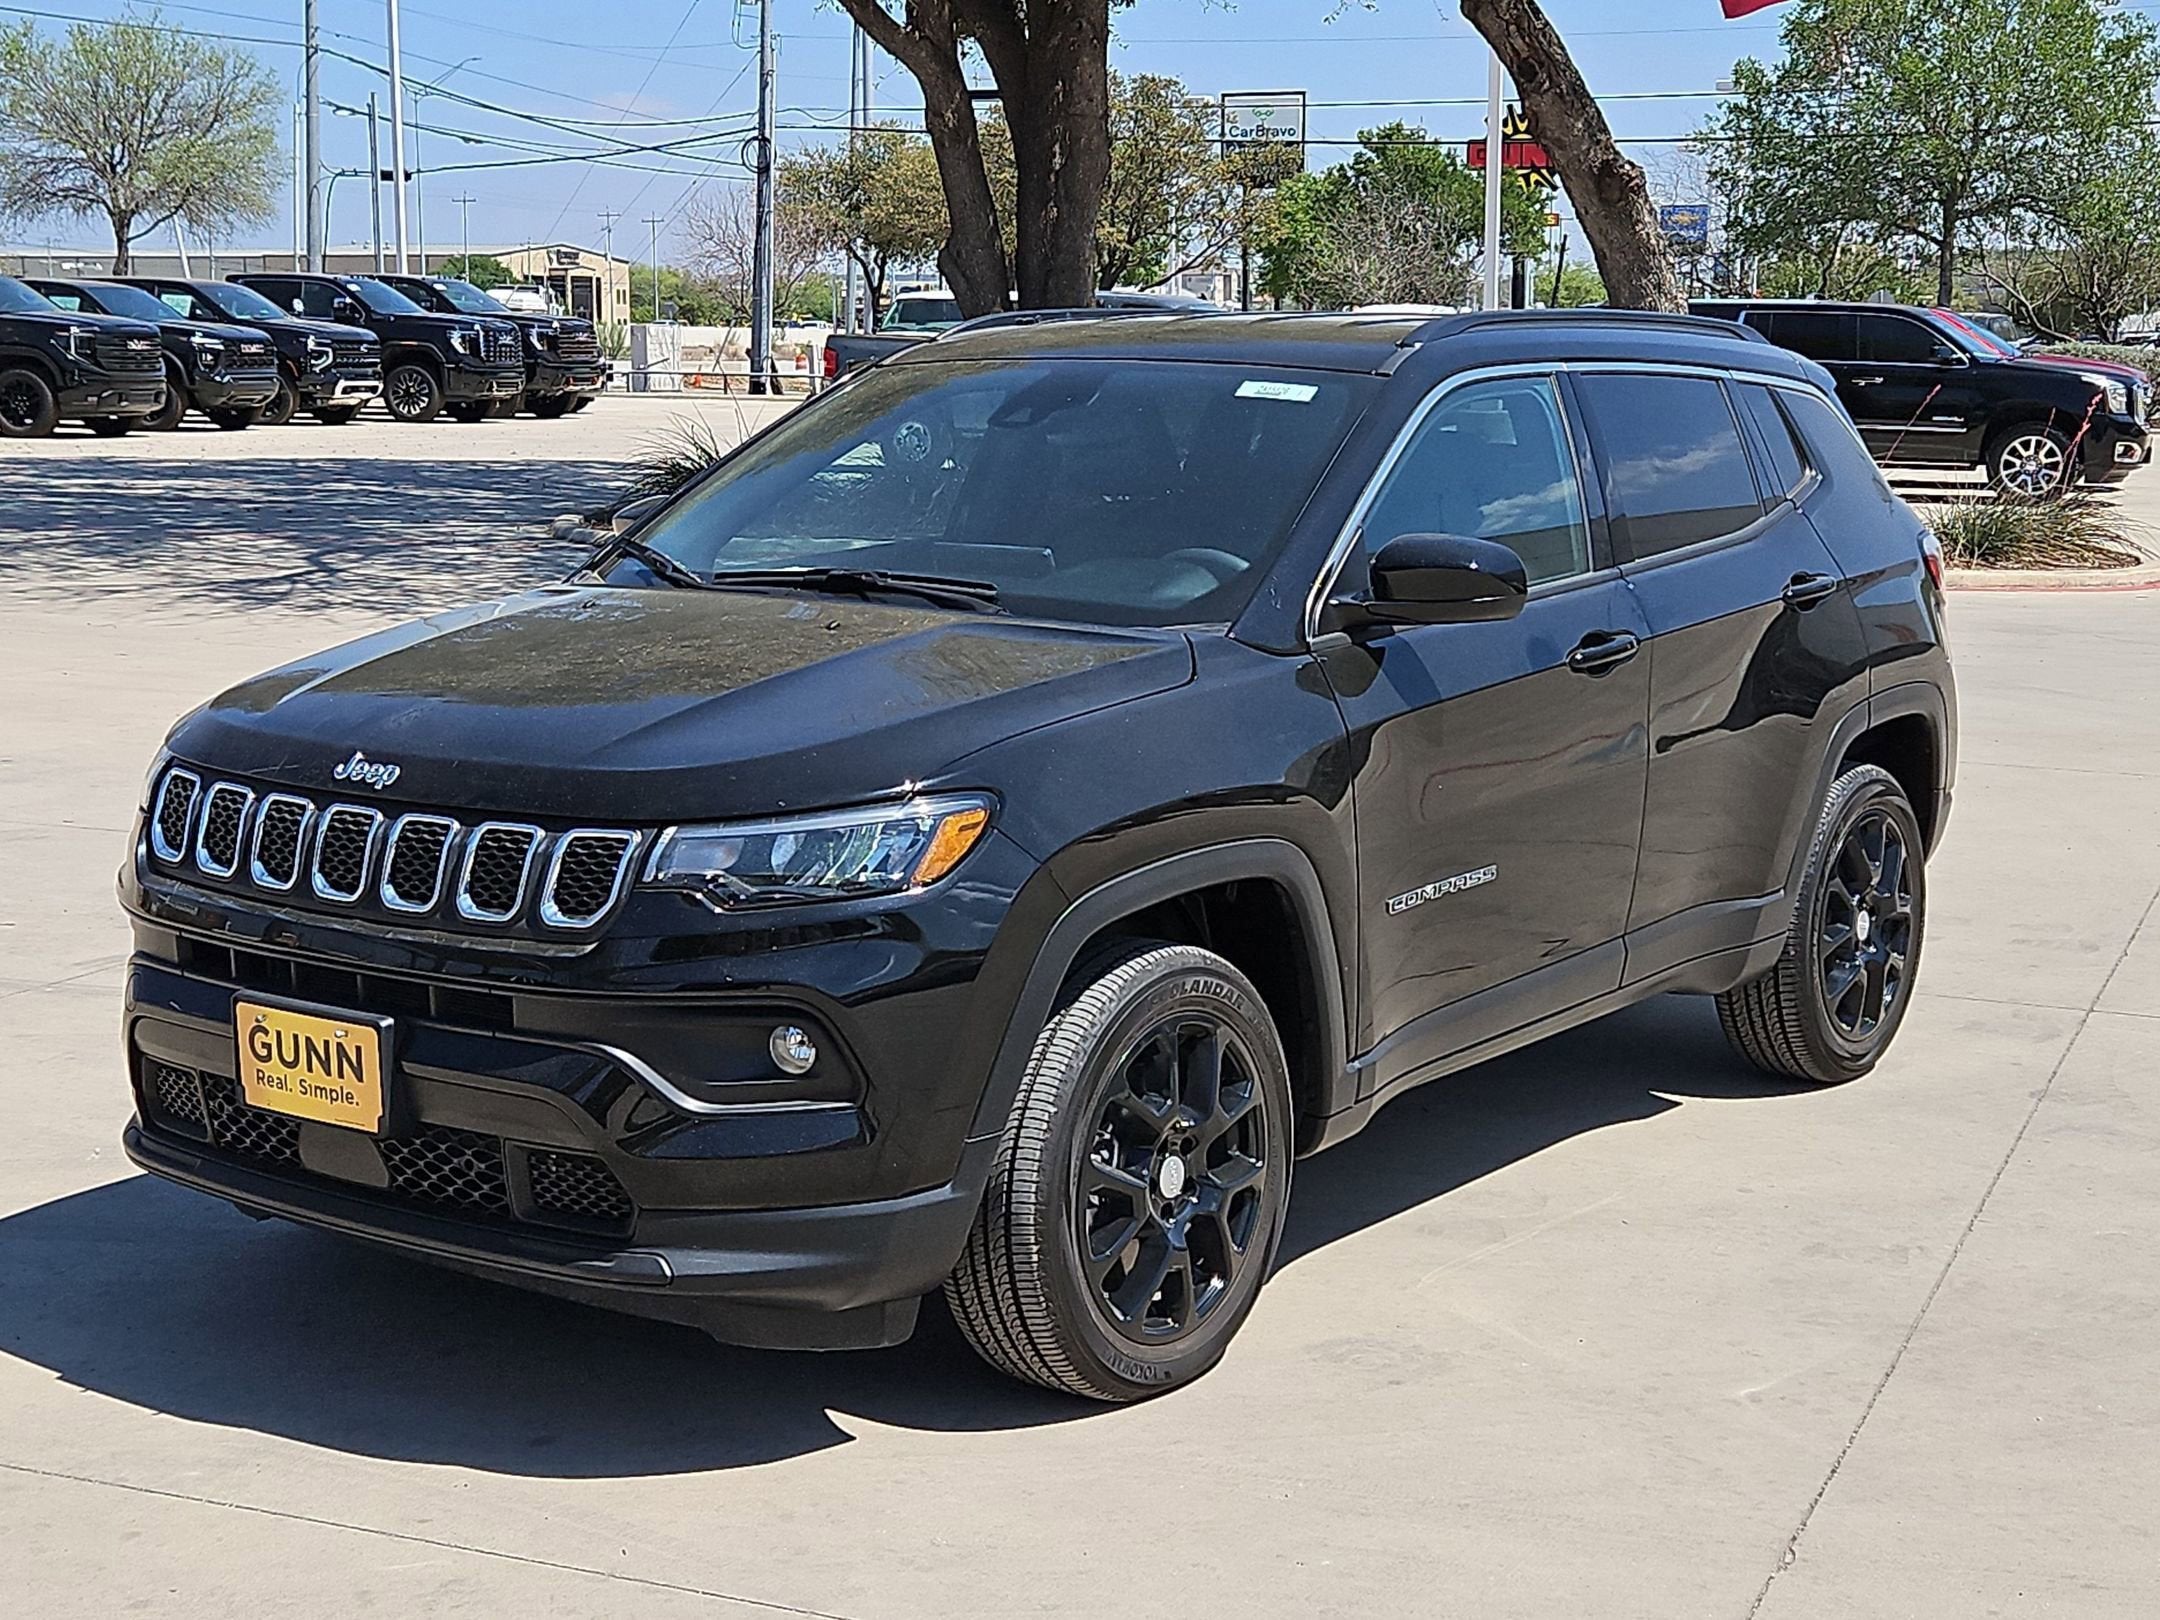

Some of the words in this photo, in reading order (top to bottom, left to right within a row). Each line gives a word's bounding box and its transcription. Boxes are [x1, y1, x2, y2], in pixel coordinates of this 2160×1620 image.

[1228, 124, 1297, 138] CarBravo
[1469, 143, 1553, 167] GUN
[333, 750, 401, 790] Jeep
[1387, 864, 1498, 915] COMPASS
[248, 1023, 365, 1083] GUNN
[255, 1068, 294, 1093] Real.
[298, 1078, 360, 1107] Simple.
